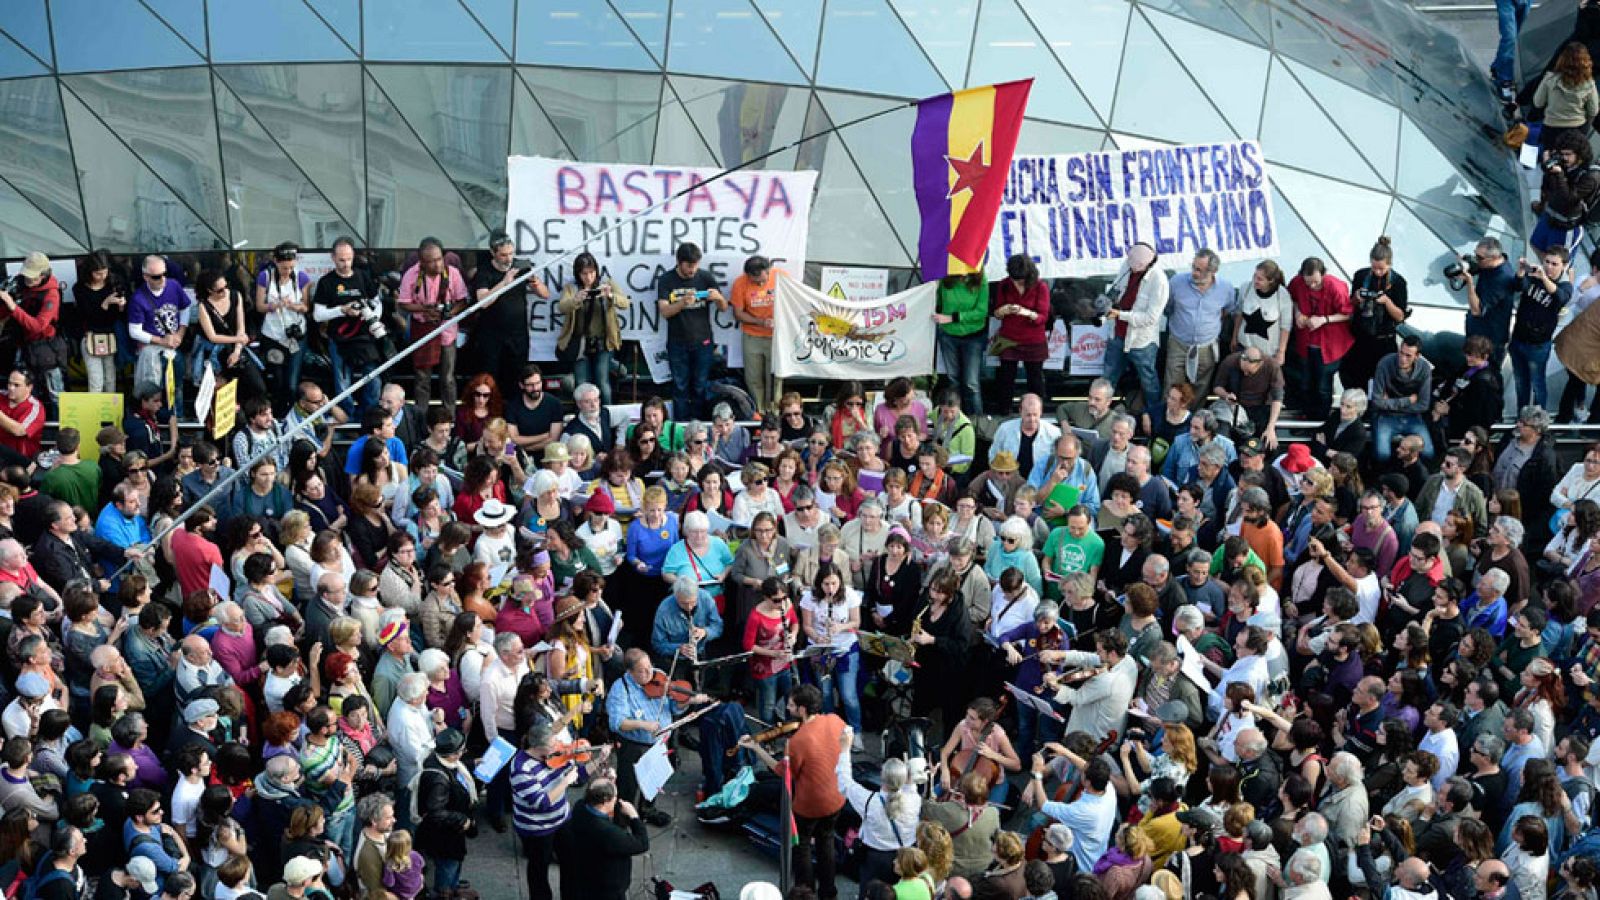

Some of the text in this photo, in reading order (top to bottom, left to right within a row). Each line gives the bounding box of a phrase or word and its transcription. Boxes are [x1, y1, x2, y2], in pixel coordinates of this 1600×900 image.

[557, 166, 793, 219] BASTA YA
[1001, 141, 1264, 206] UCHA SIN FRONTERAS
[515, 216, 761, 257] DE MUERTES
[1150, 189, 1272, 254] CAMINO
[626, 262, 728, 293] CAE
